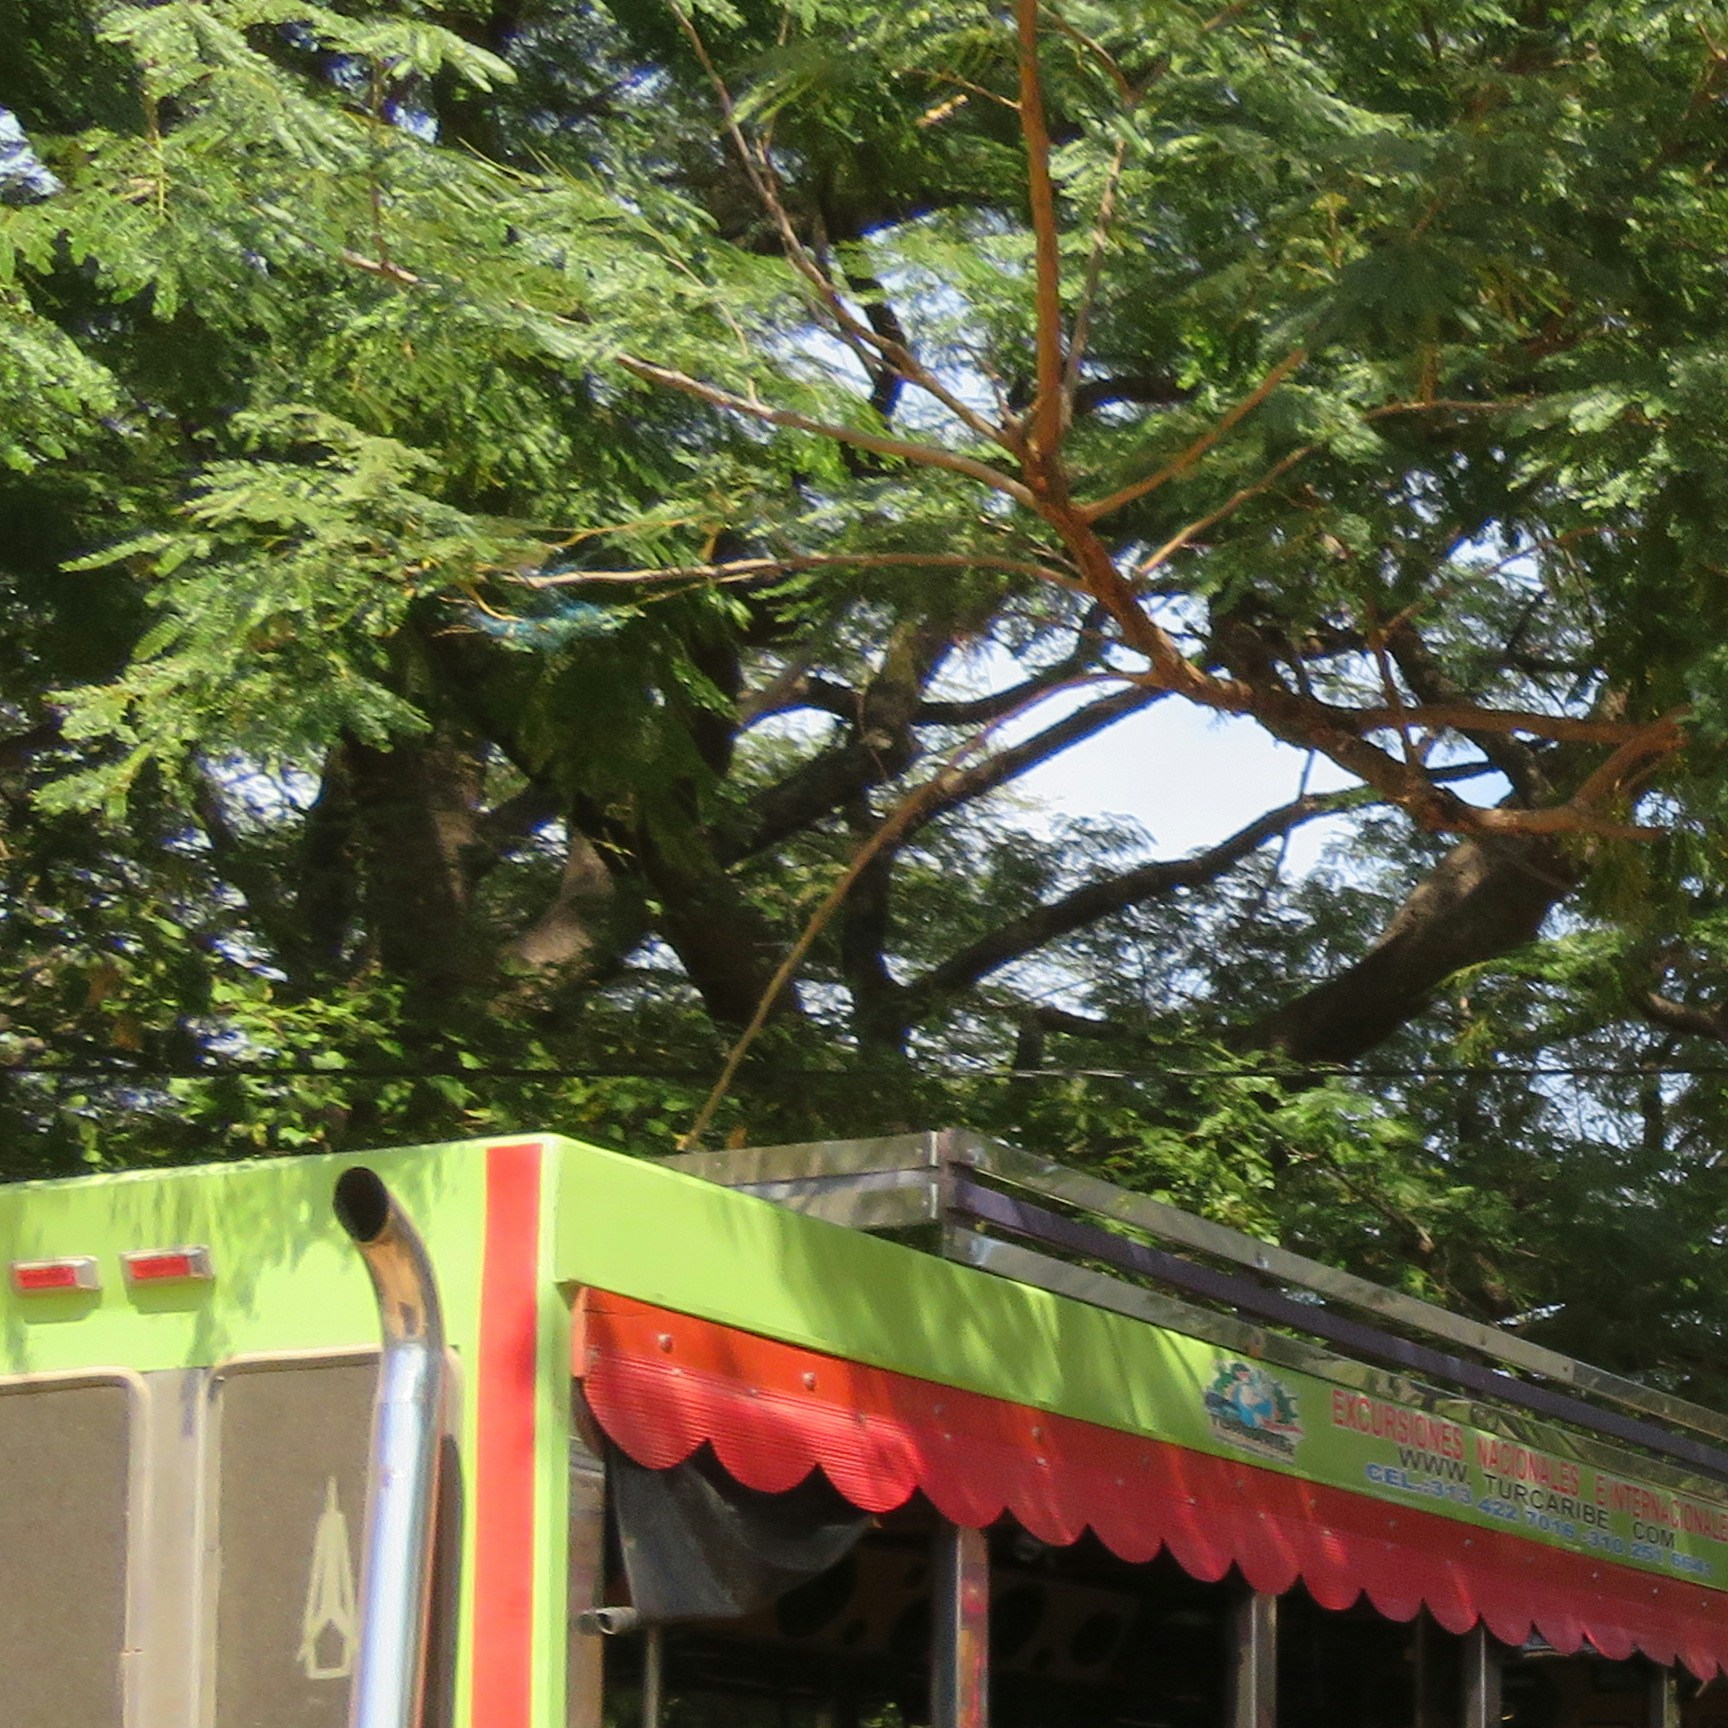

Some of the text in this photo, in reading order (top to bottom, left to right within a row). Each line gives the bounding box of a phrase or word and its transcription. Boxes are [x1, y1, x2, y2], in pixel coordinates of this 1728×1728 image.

[1331, 1388, 1464, 1461] EXCURSIONES
[1476, 1435, 1580, 1498] NACIONALES
[1485, 1473, 1610, 1530] TURCARIBE
